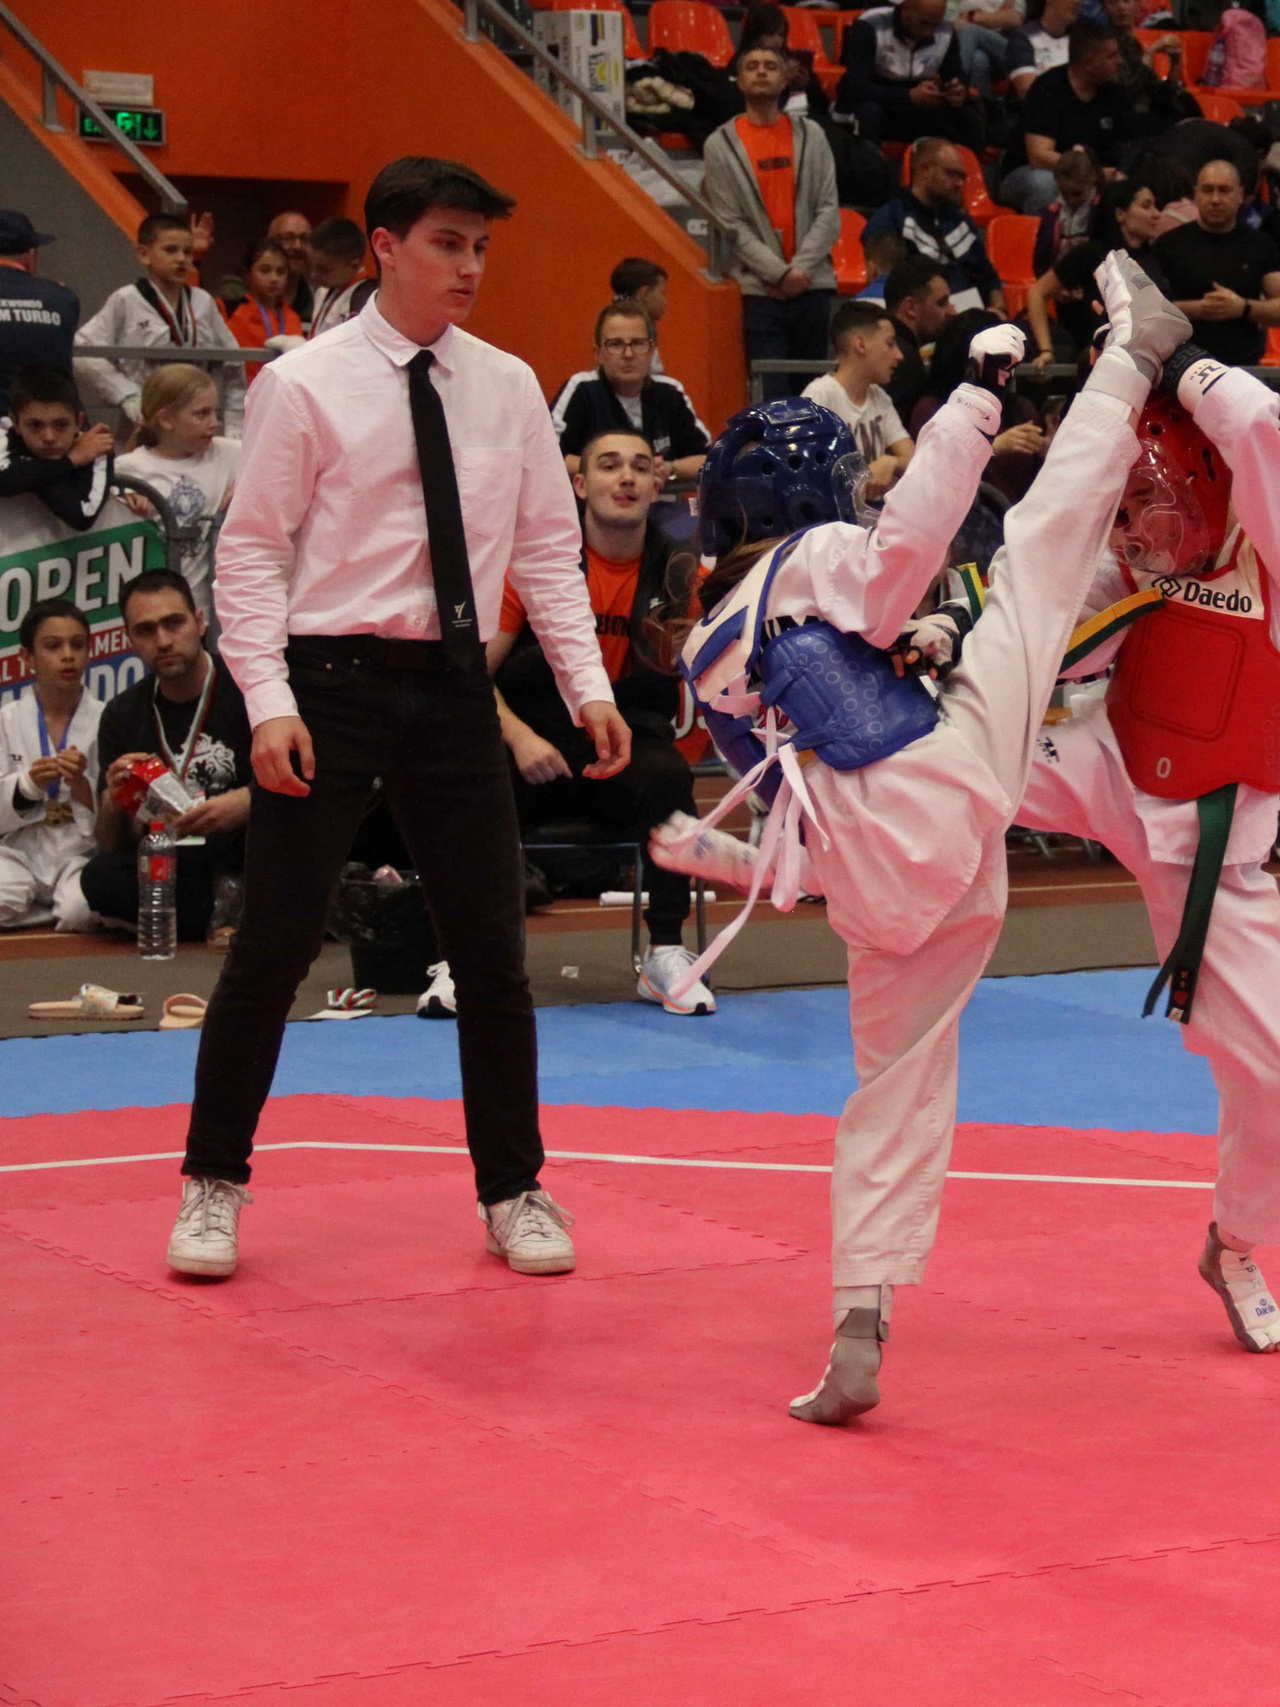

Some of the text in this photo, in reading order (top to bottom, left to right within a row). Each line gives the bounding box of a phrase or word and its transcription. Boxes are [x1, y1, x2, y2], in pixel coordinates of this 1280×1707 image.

[12, 310, 62, 326] TURBO
[0, 536, 145, 632] OPEN
[1183, 581, 1252, 613] Daedo
